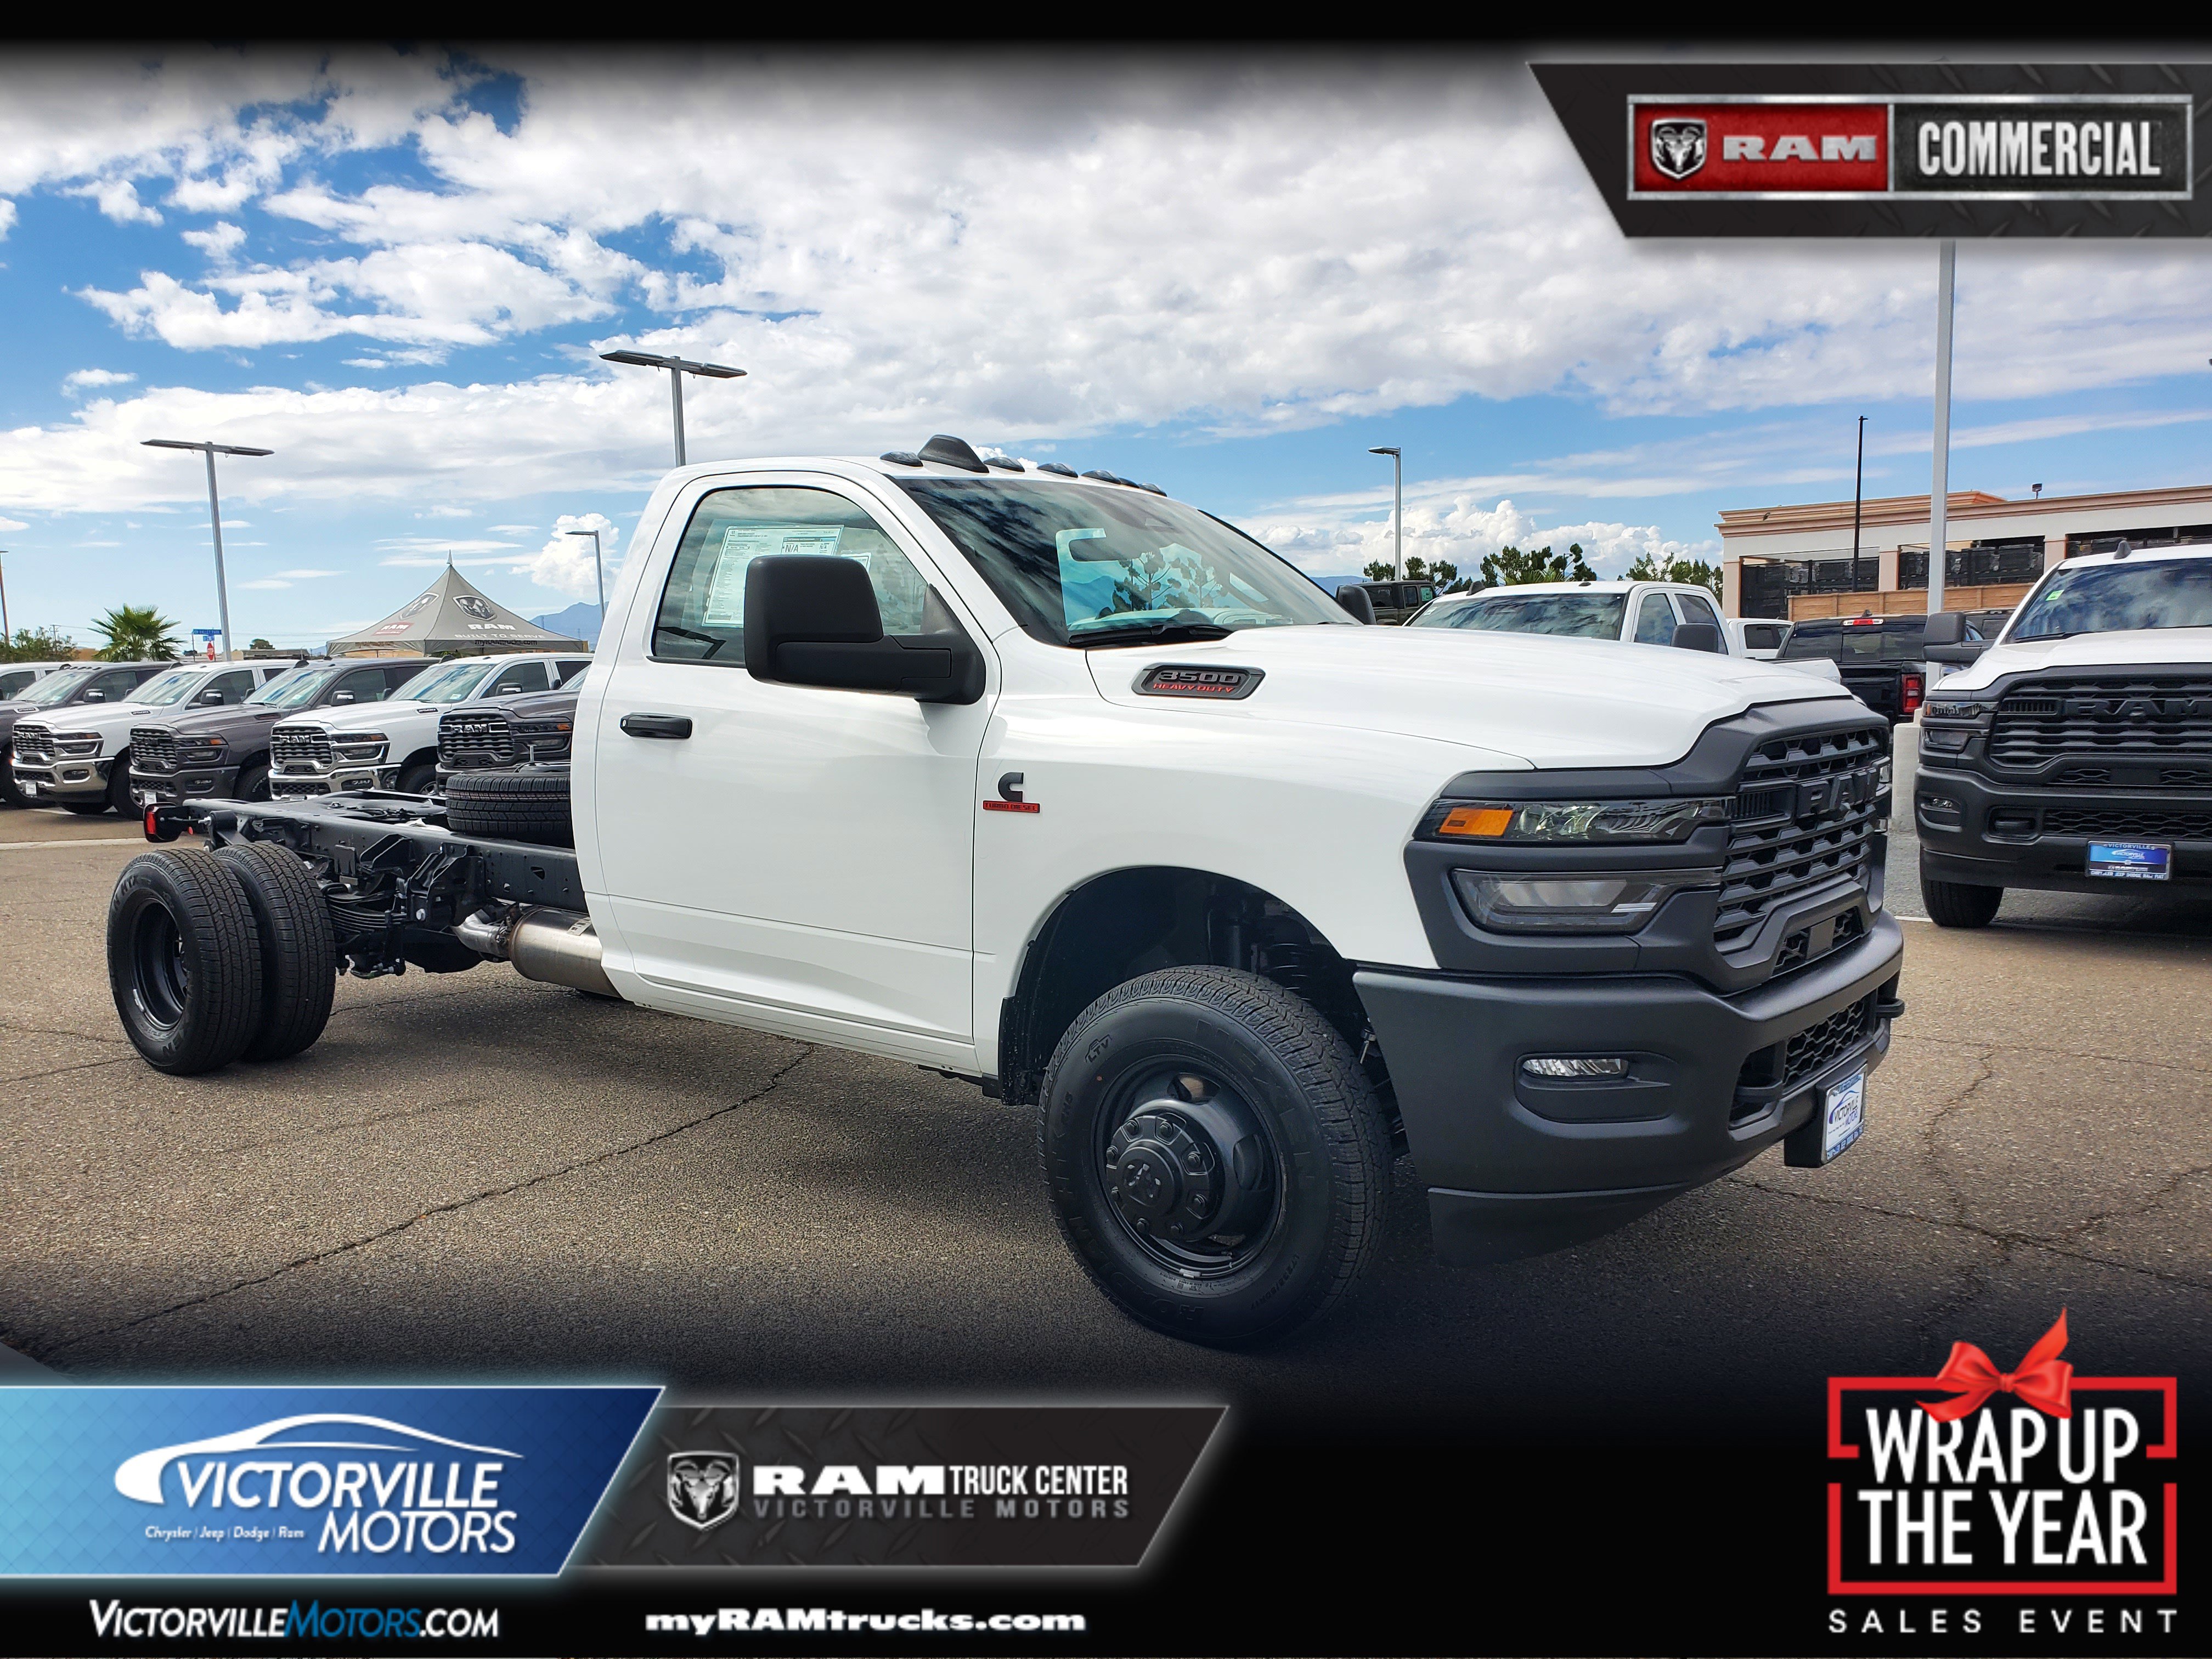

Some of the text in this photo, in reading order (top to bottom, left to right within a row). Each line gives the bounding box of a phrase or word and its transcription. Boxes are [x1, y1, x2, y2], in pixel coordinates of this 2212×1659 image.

[785, 544, 799, 552] N/A
[1159, 671, 1241, 685] 3500
[2065, 699, 2212, 715] RAM
[450, 724, 488, 733] RAM
[280, 735, 310, 743] RAM
[1797, 768, 1877, 819] RAM
[1087, 1039, 1111, 1063] LTV
